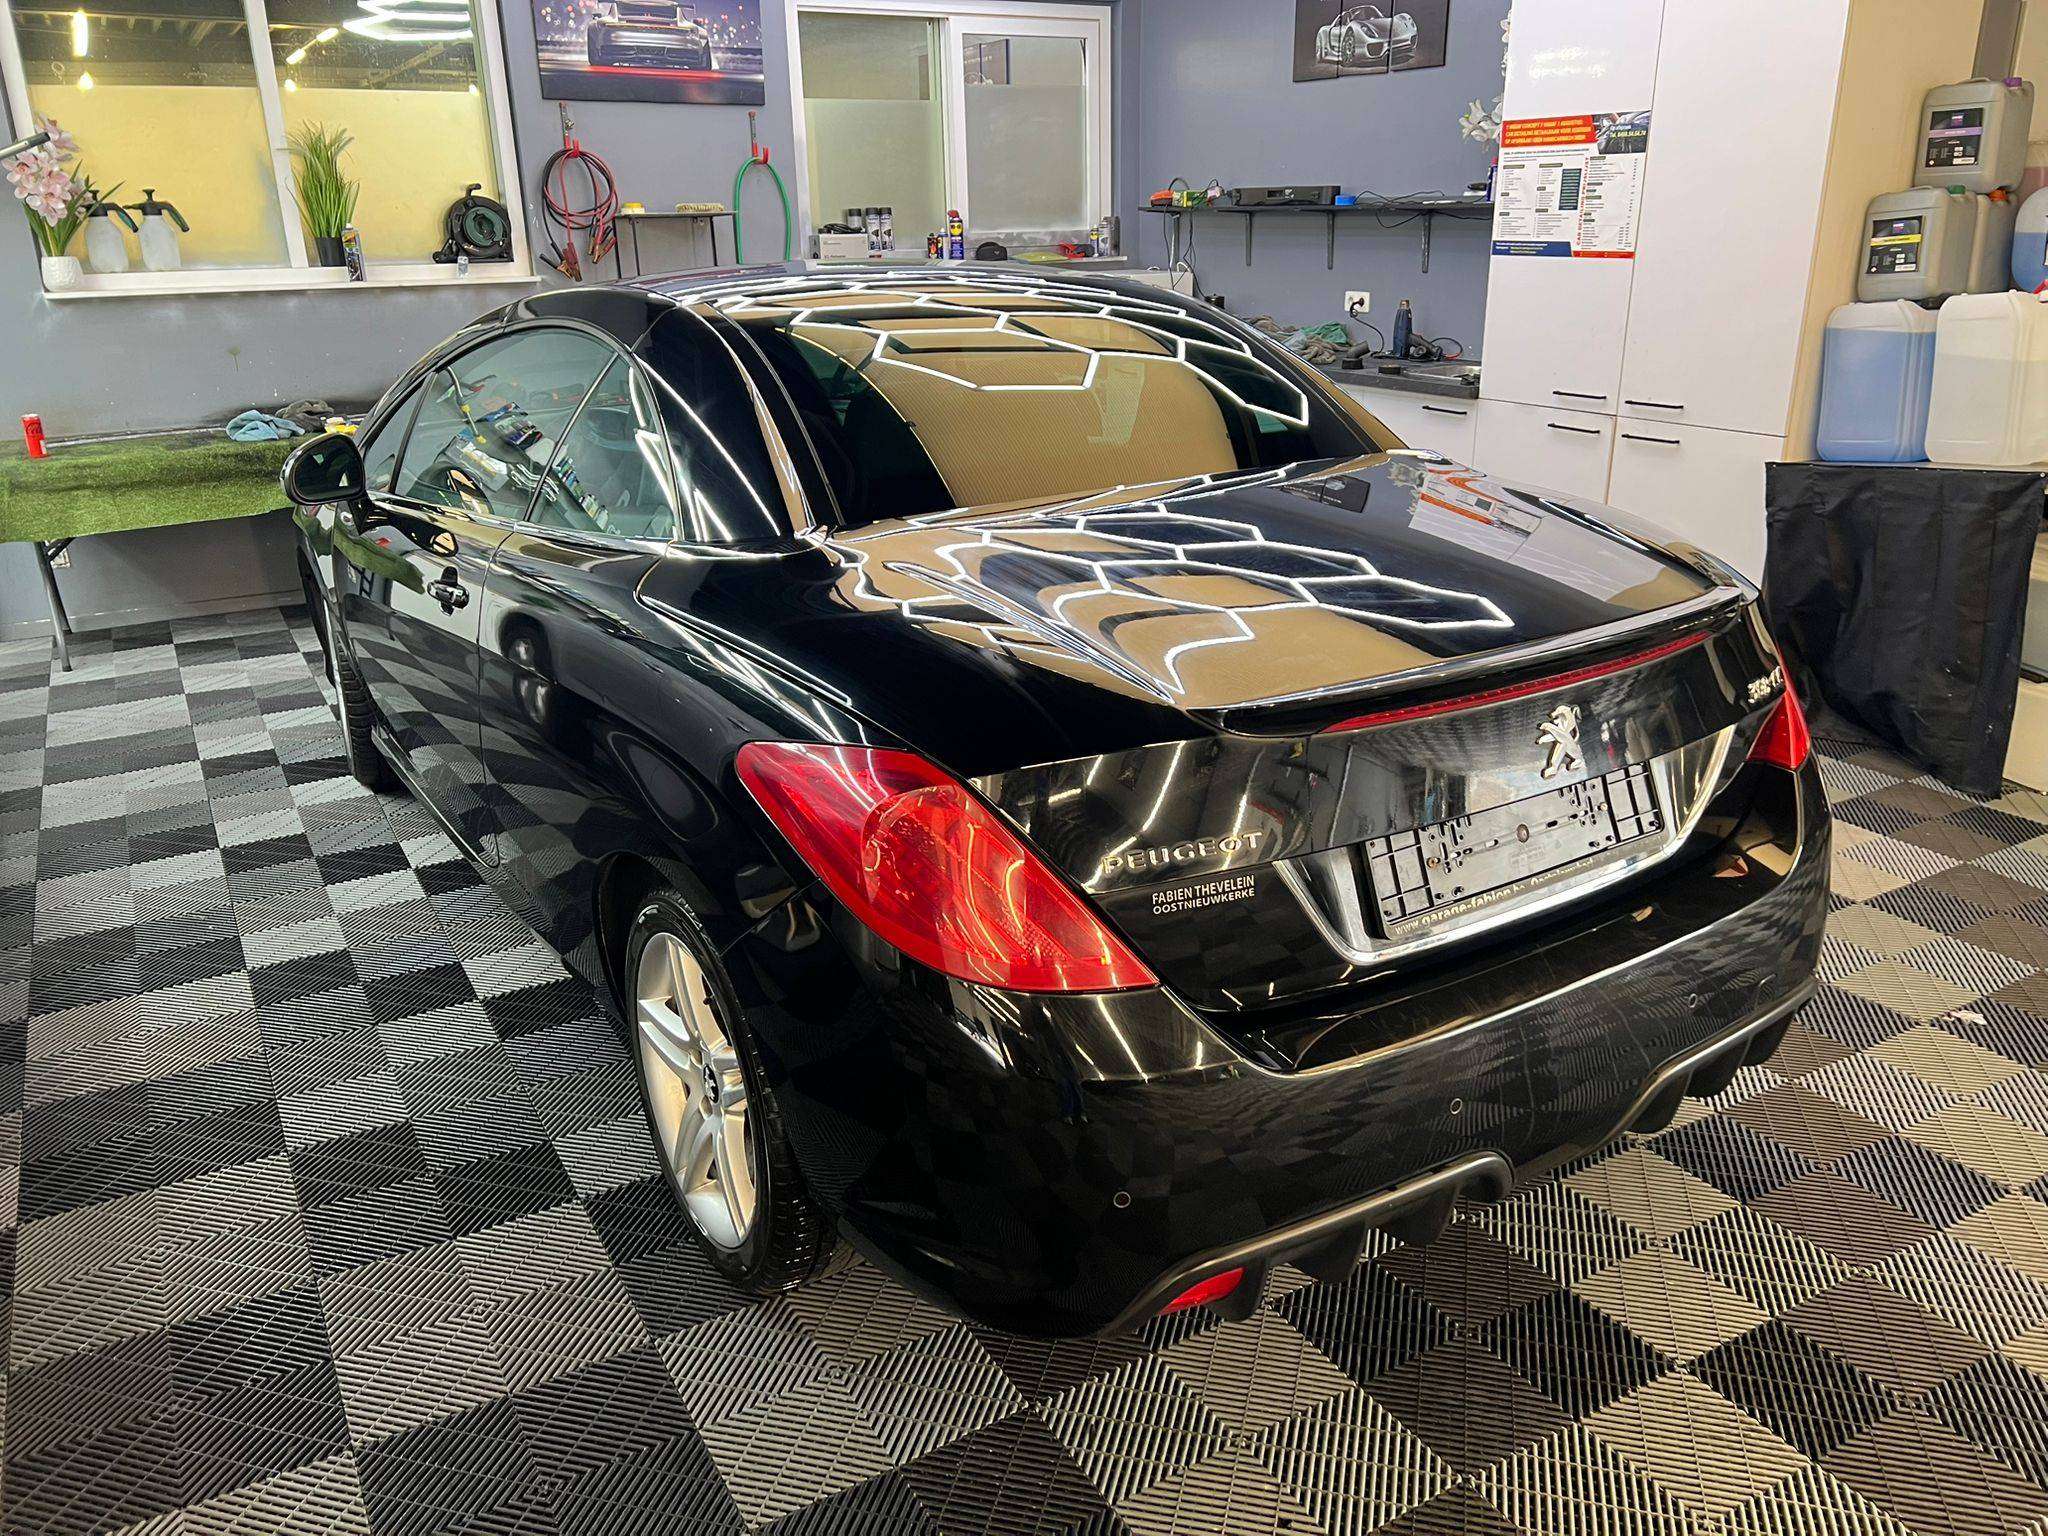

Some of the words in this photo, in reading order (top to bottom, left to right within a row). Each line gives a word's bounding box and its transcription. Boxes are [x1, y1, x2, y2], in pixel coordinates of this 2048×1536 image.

[1101, 832, 1263, 874] PEUGEOT
[1152, 886, 1193, 905] FABIEN
[1193, 875, 1255, 898] THEVELEIN
[1153, 887, 1255, 915] OOSTNIEUWKERKE
